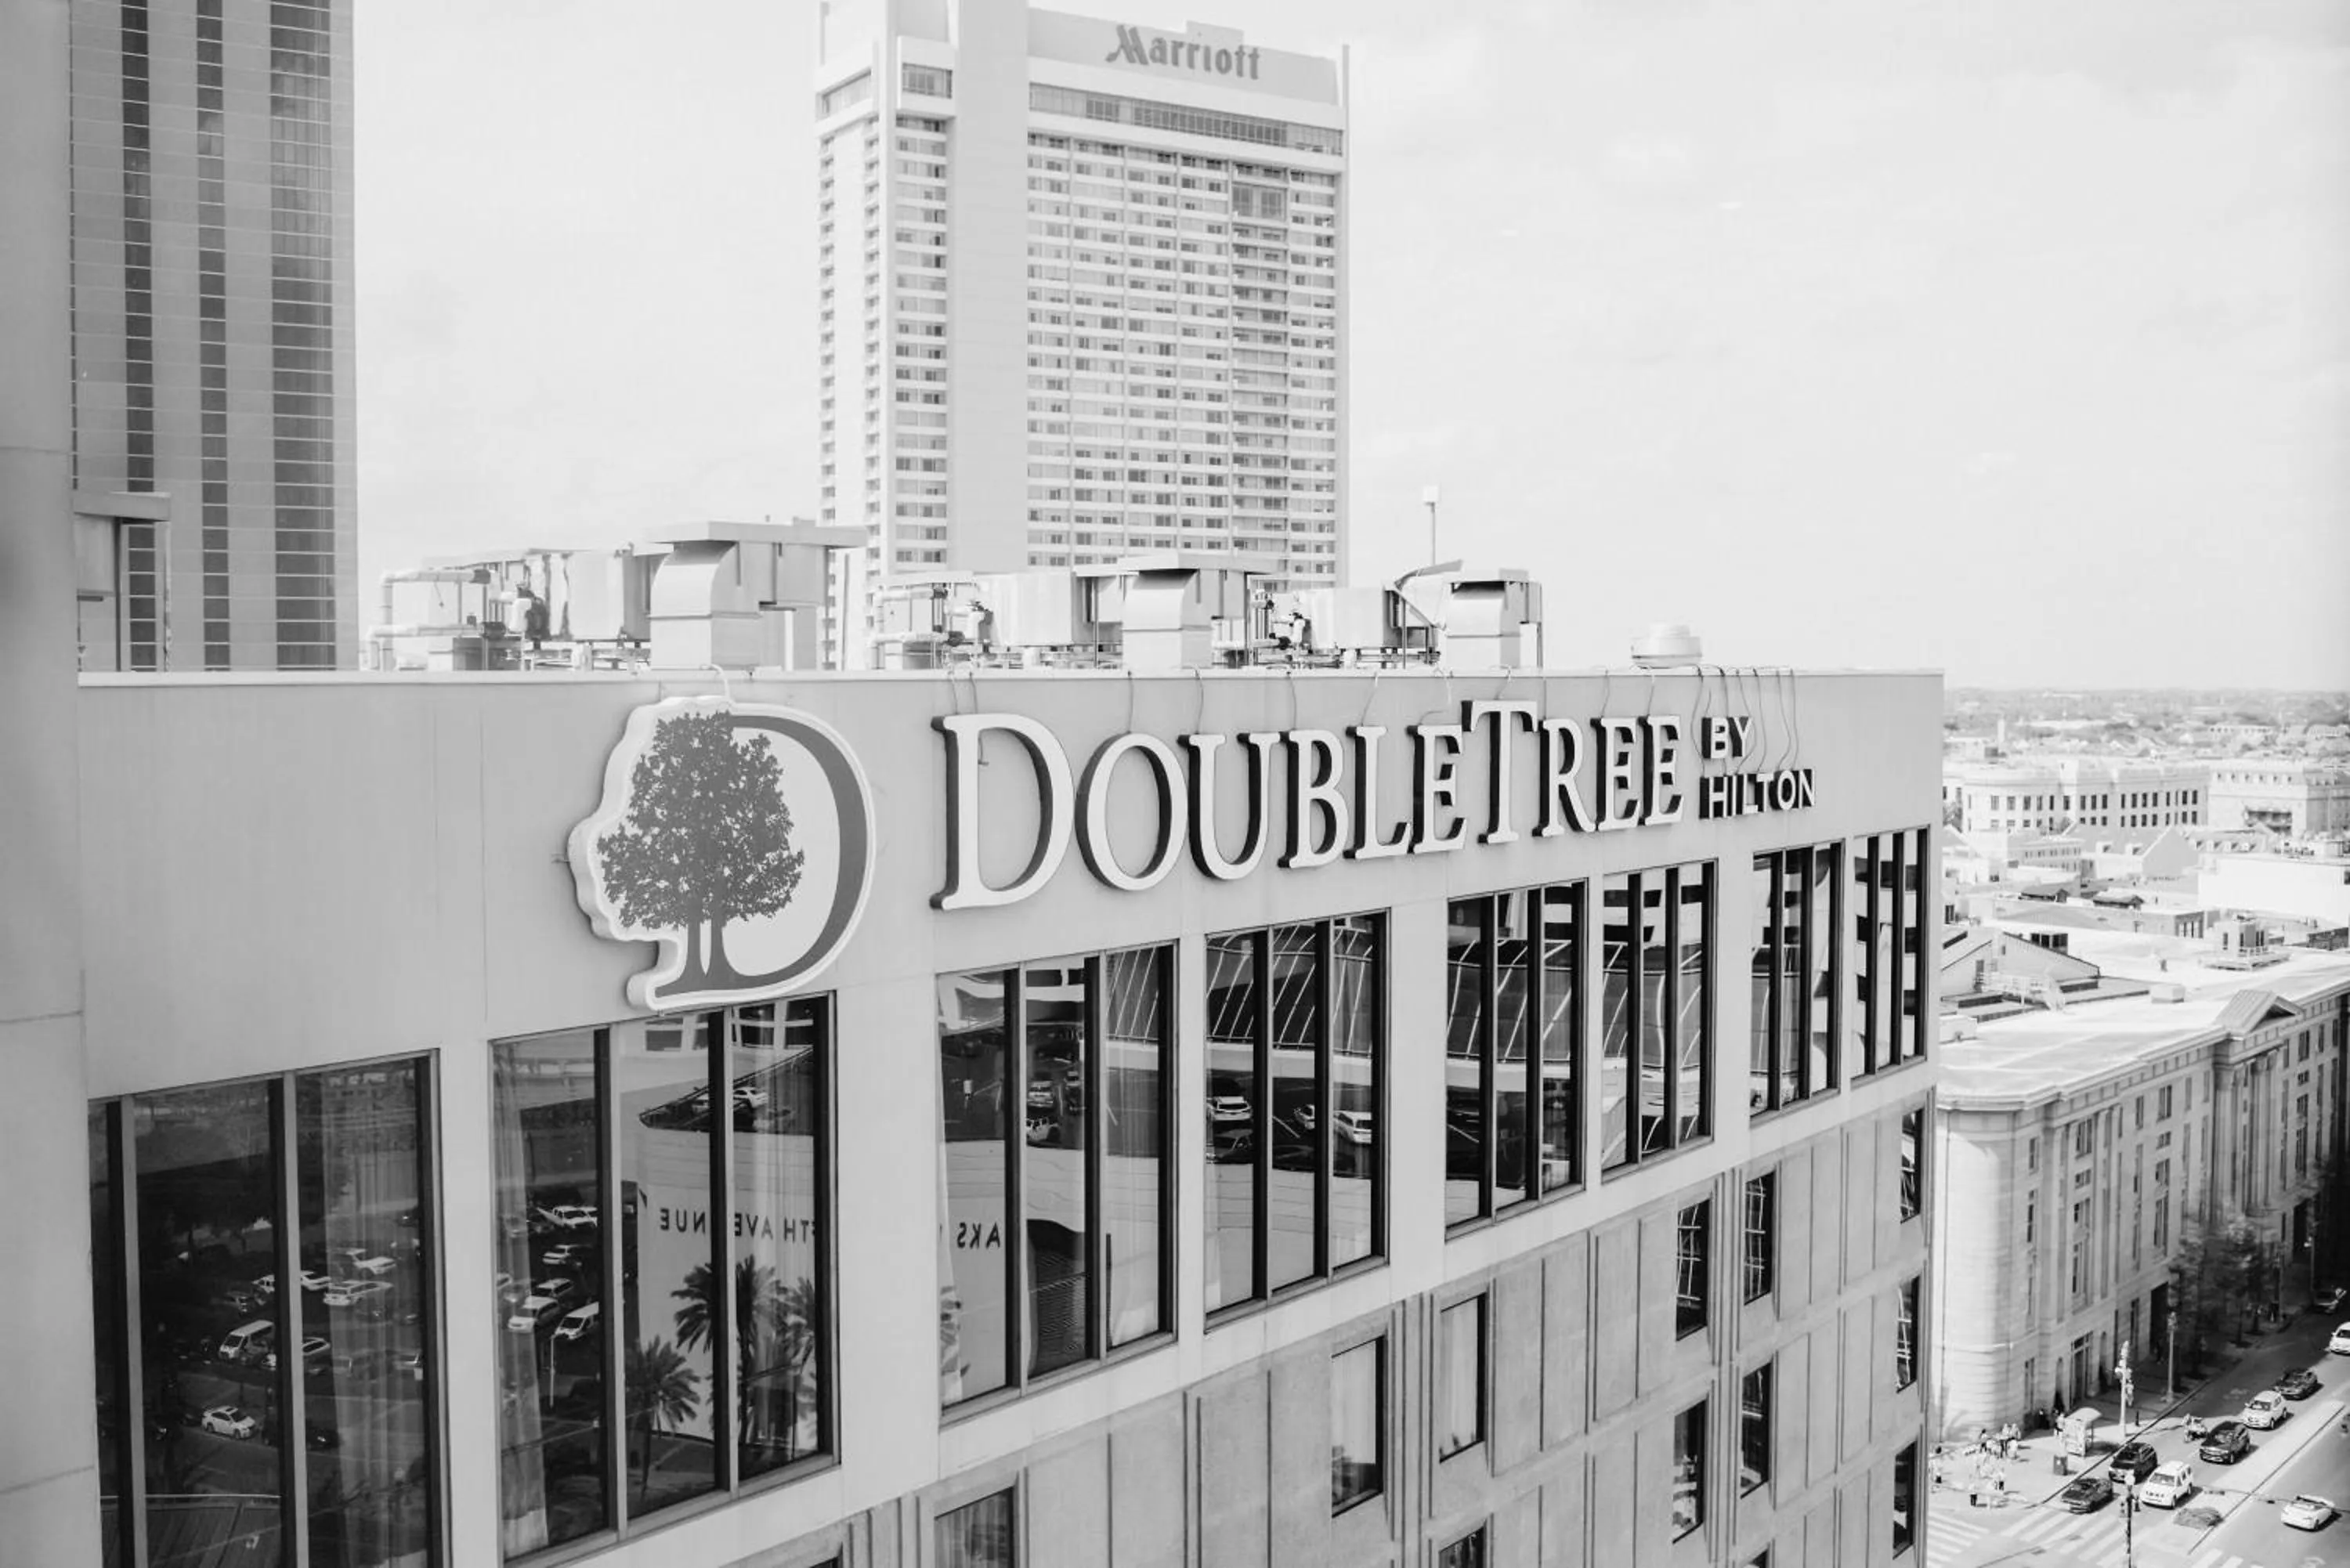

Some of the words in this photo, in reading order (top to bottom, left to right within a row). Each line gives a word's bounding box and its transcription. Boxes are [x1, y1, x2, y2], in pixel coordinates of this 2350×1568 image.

[1105, 24, 1260, 80] Marriott
[1701, 715, 1752, 759] BY
[1699, 768, 1816, 819] HILTON
